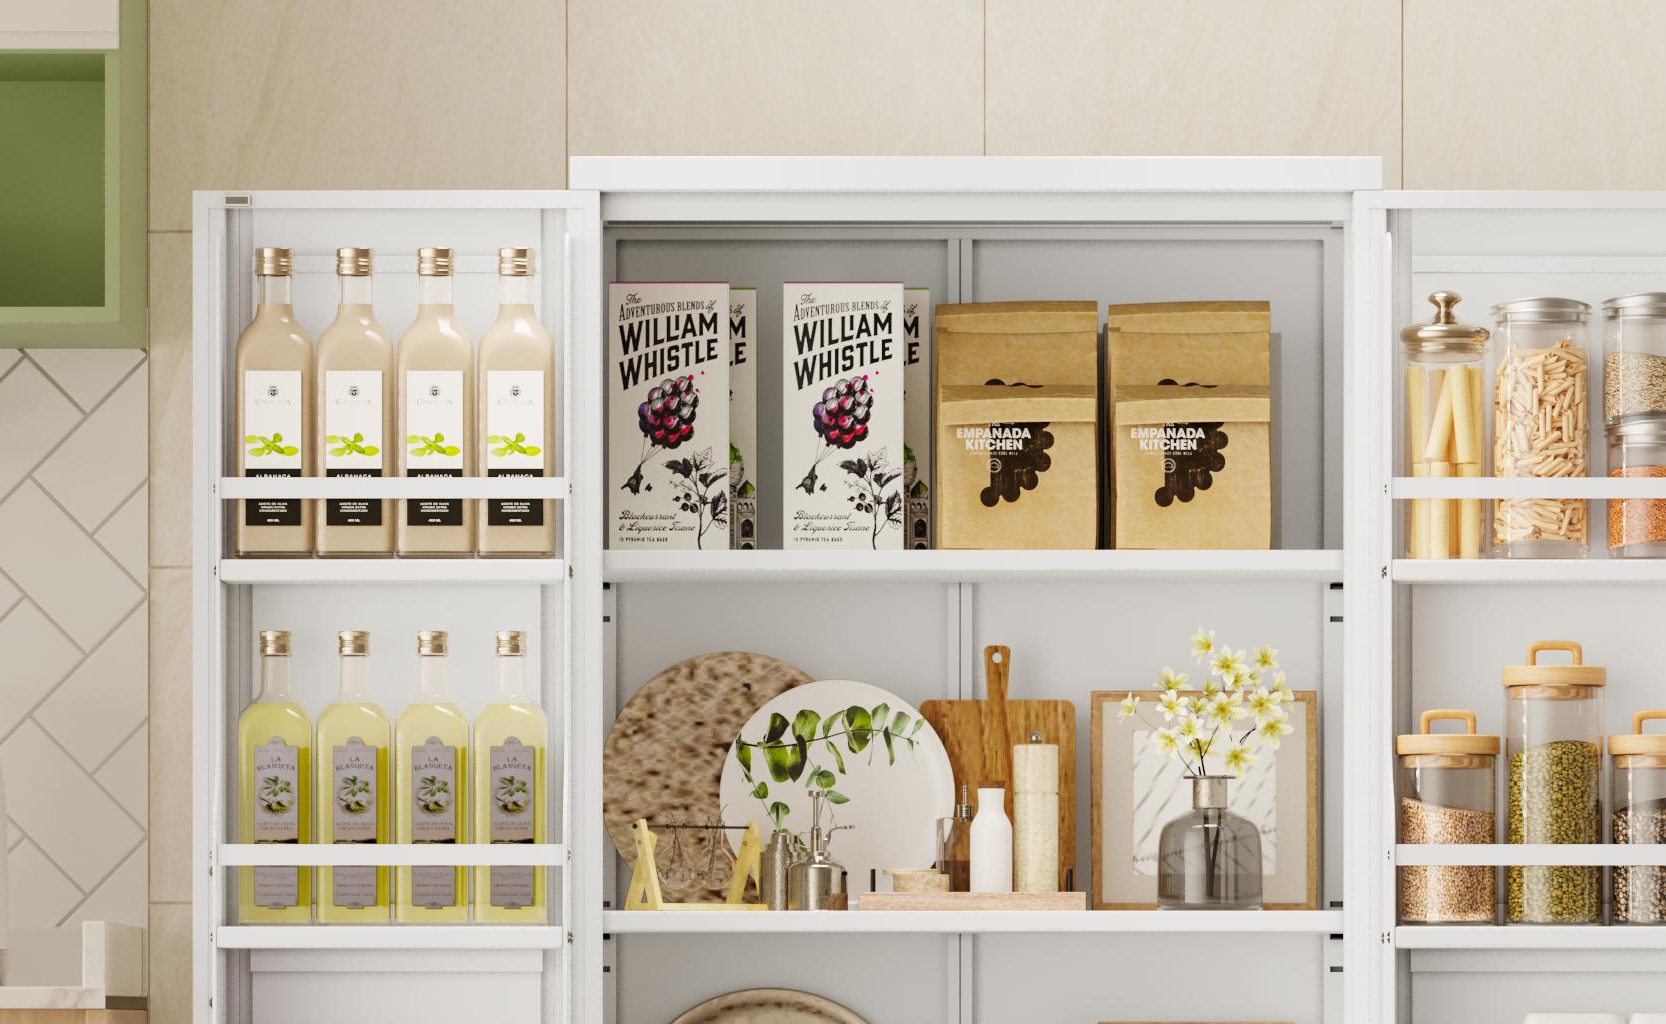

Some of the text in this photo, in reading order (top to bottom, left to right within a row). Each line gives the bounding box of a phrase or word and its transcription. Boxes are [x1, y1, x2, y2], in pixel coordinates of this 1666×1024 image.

[626, 293, 642, 305] The
[800, 293, 817, 305] The
[619, 303, 675, 321] ADVENTUROUS
[677, 301, 704, 311] BLENDS
[793, 303, 849, 321] ADVENTUROUS
[852, 301, 879, 311] BLENDS
[619, 313, 718, 355] WILLIAM
[793, 313, 892, 355] WILLIAM
[619, 339, 718, 390] WHISTLE
[794, 339, 892, 390] WHISTLE
[956, 428, 1031, 439] EMPANADA
[1130, 427, 1205, 439] EMPANADA
[965, 439, 1023, 450] KITCHEN
[1139, 439, 1197, 451] KITCHEN
[619, 510, 676, 520] Blackcurrant
[794, 510, 851, 520] Blackcurrant
[626, 521, 667, 534] Liquorice
[669, 521, 696, 531] Tisane
[801, 521, 841, 534] Liquorice
[844, 521, 870, 531] Tisane
